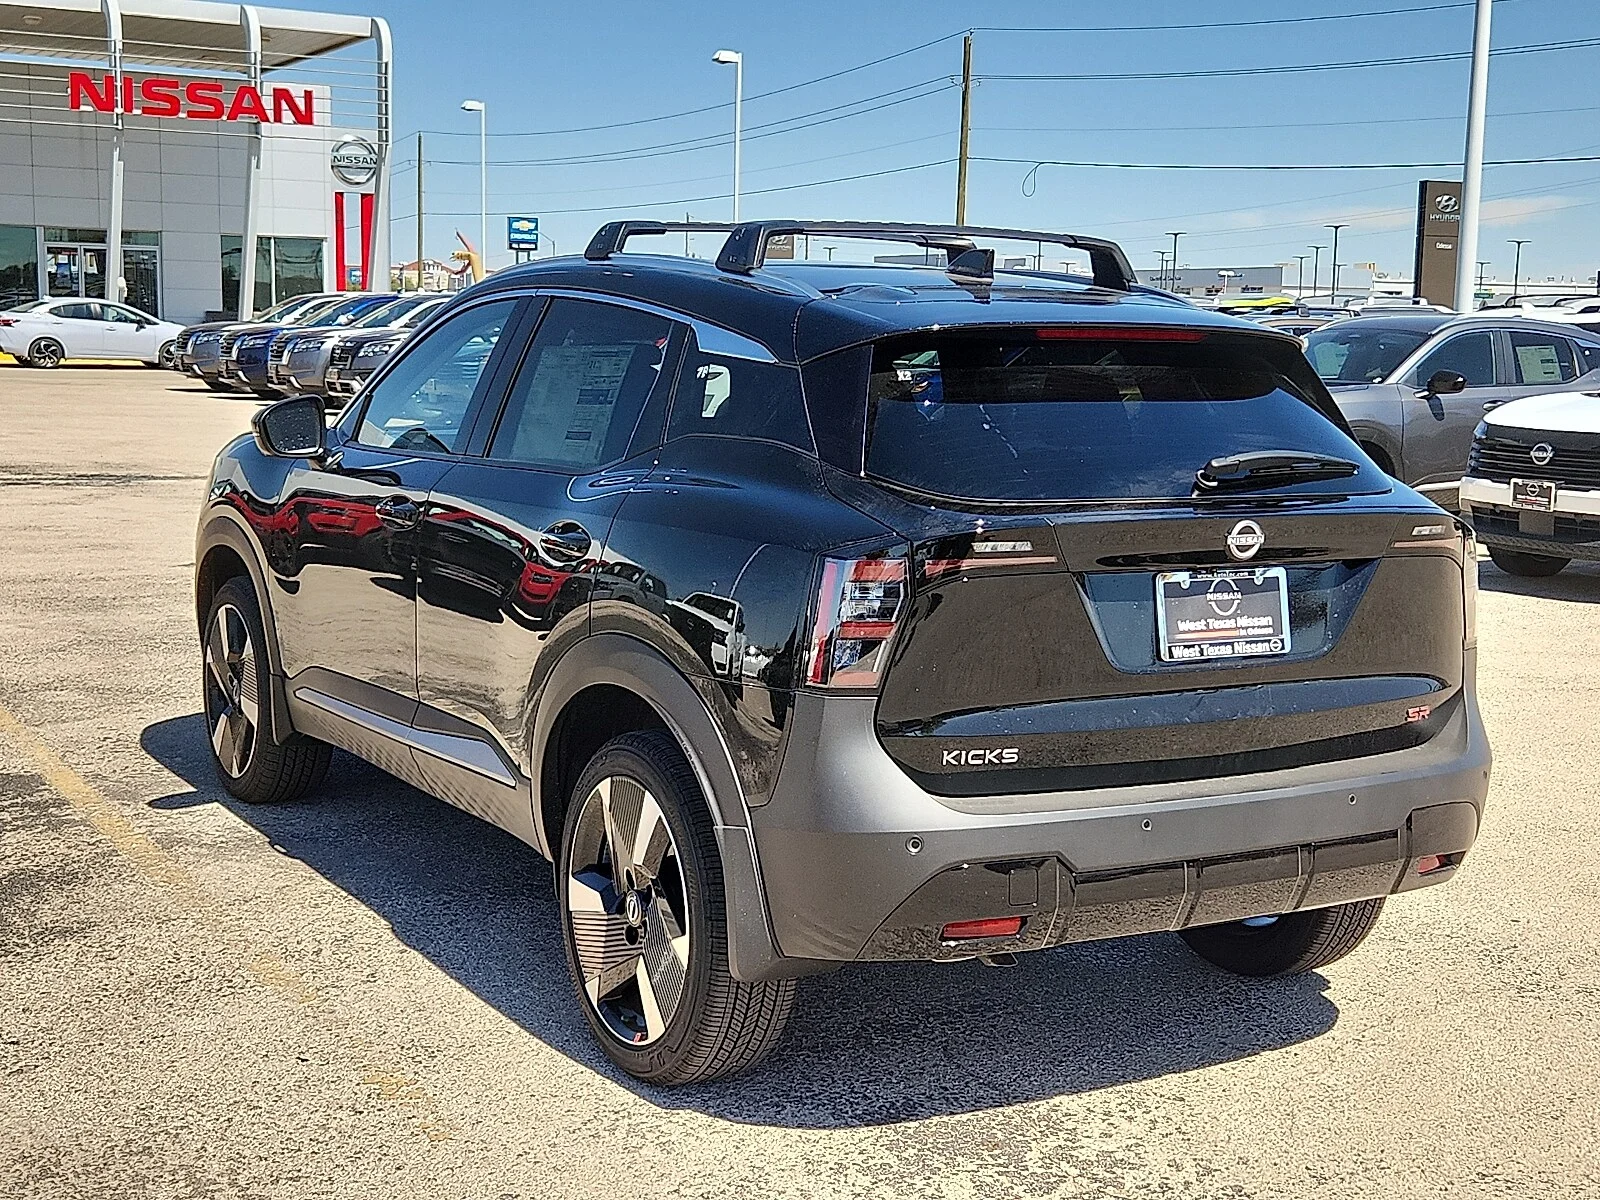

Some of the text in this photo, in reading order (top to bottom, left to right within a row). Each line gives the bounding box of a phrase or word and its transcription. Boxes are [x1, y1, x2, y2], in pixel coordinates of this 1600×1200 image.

[69, 71, 315, 126] NISSAN
[332, 155, 378, 165] NISSAN
[1229, 535, 1264, 545] NISSAN
[1206, 591, 1243, 601] NISSAN
[1177, 615, 1273, 631] West Texas Nissan
[1171, 641, 1270, 659] West Texas Nissan
[1406, 705, 1430, 721] SR
[942, 748, 1019, 766] KICKS
